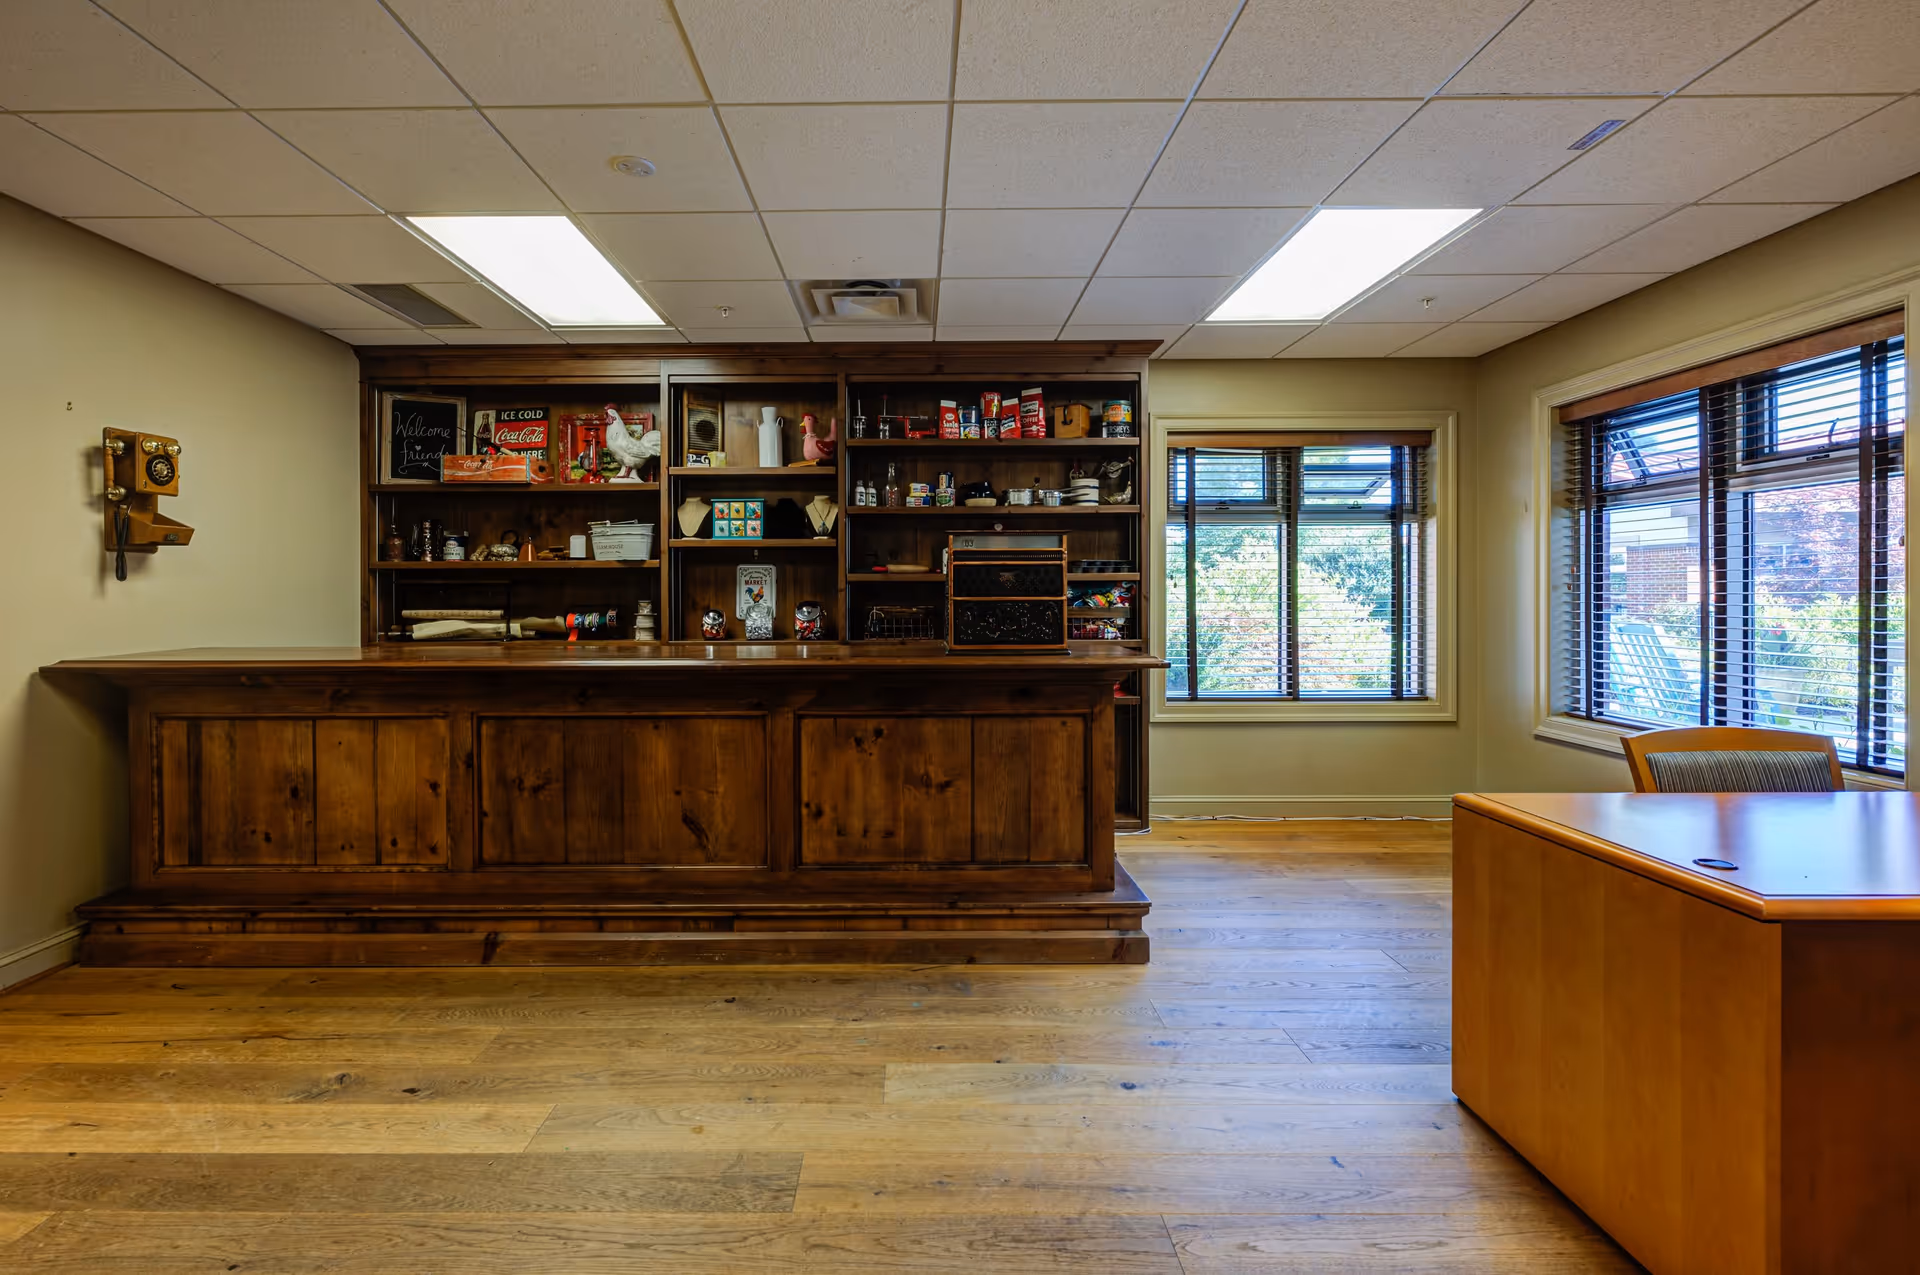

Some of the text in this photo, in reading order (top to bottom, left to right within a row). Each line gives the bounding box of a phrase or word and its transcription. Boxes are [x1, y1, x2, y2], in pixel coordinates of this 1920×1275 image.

[394, 411, 451, 438] Welcome
[501, 410, 543, 420] ICE COLD
[495, 426, 545, 445] Coca-Cola
